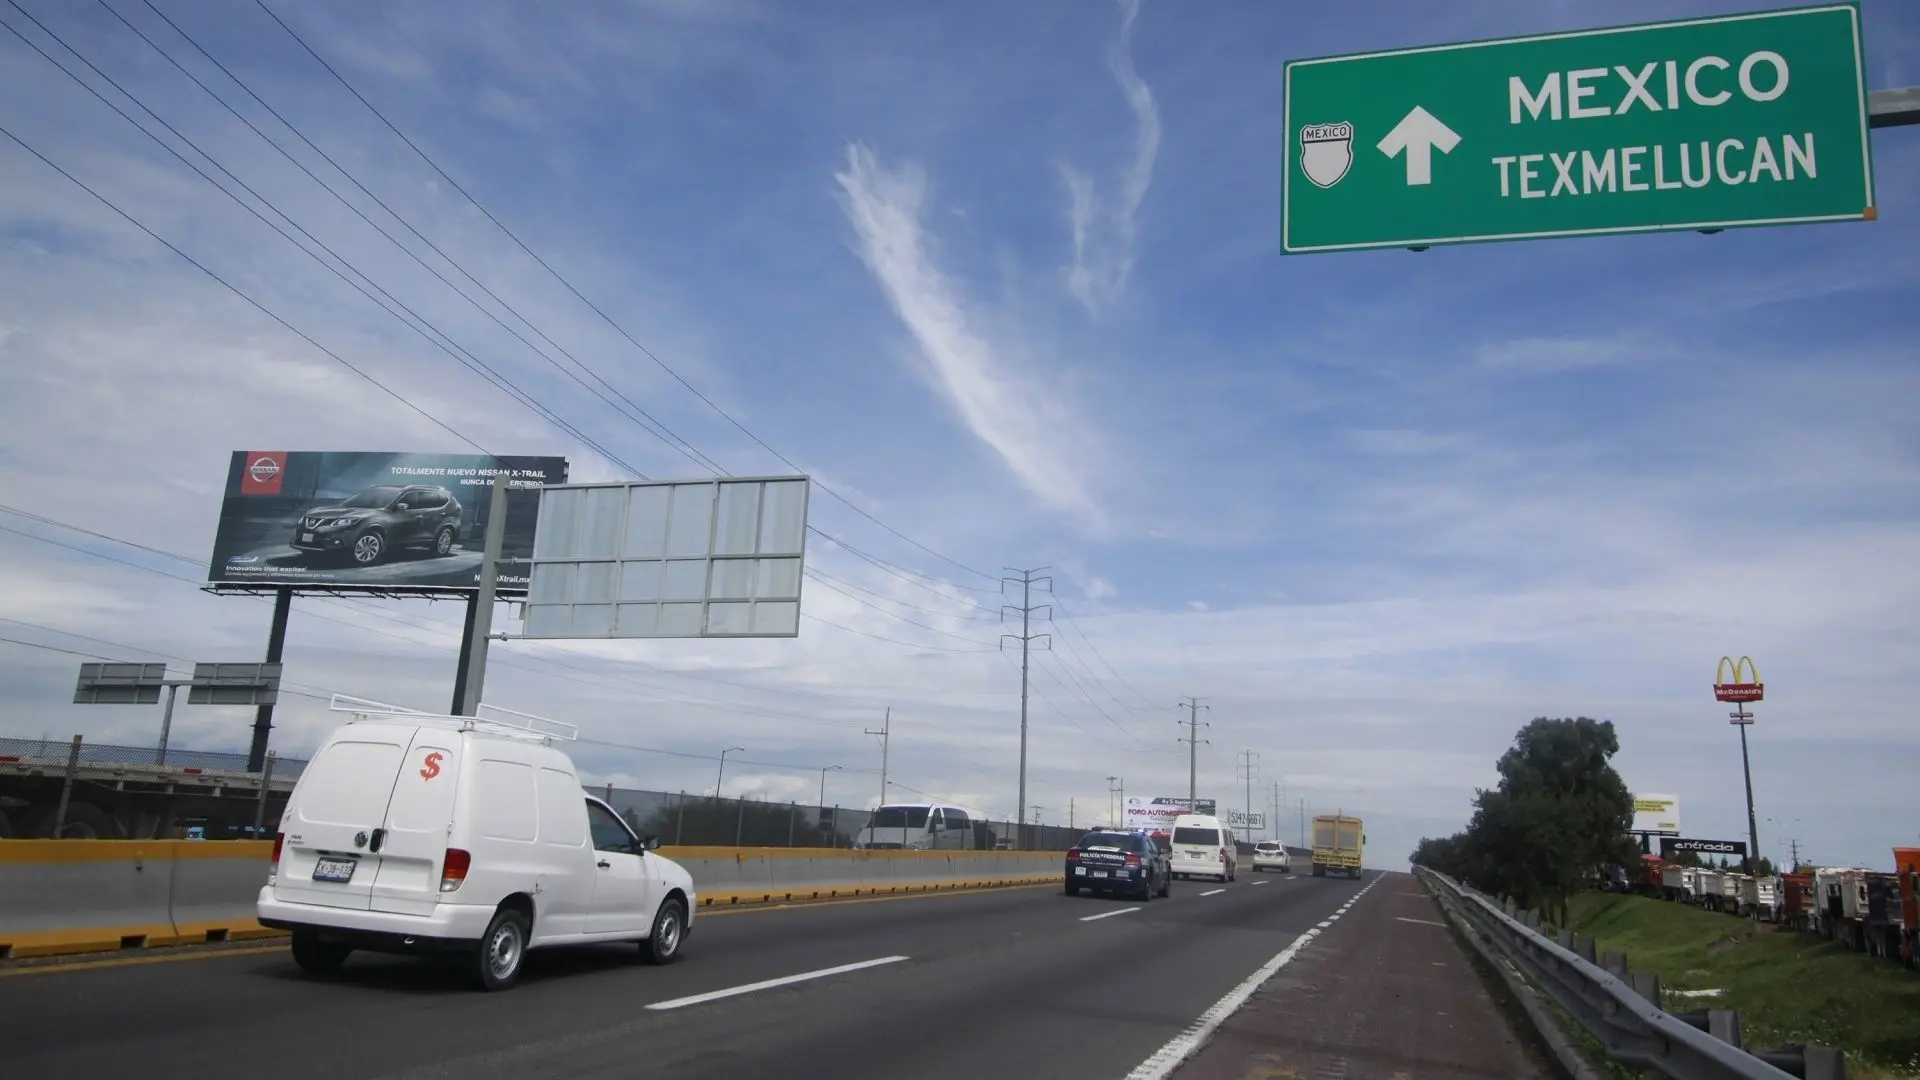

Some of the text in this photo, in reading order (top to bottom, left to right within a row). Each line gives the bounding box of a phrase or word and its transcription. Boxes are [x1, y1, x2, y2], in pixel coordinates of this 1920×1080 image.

[1509, 51, 1789, 124] MEXICO
[1306, 127, 1347, 139] MEXICO
[1492, 133, 1817, 198] TEXMELUCAN
[391, 467, 445, 475] TOTALMENTE
[447, 468, 477, 476] NUEVO
[420, 752, 443, 782] $
[1674, 841, 1734, 851] entrada
